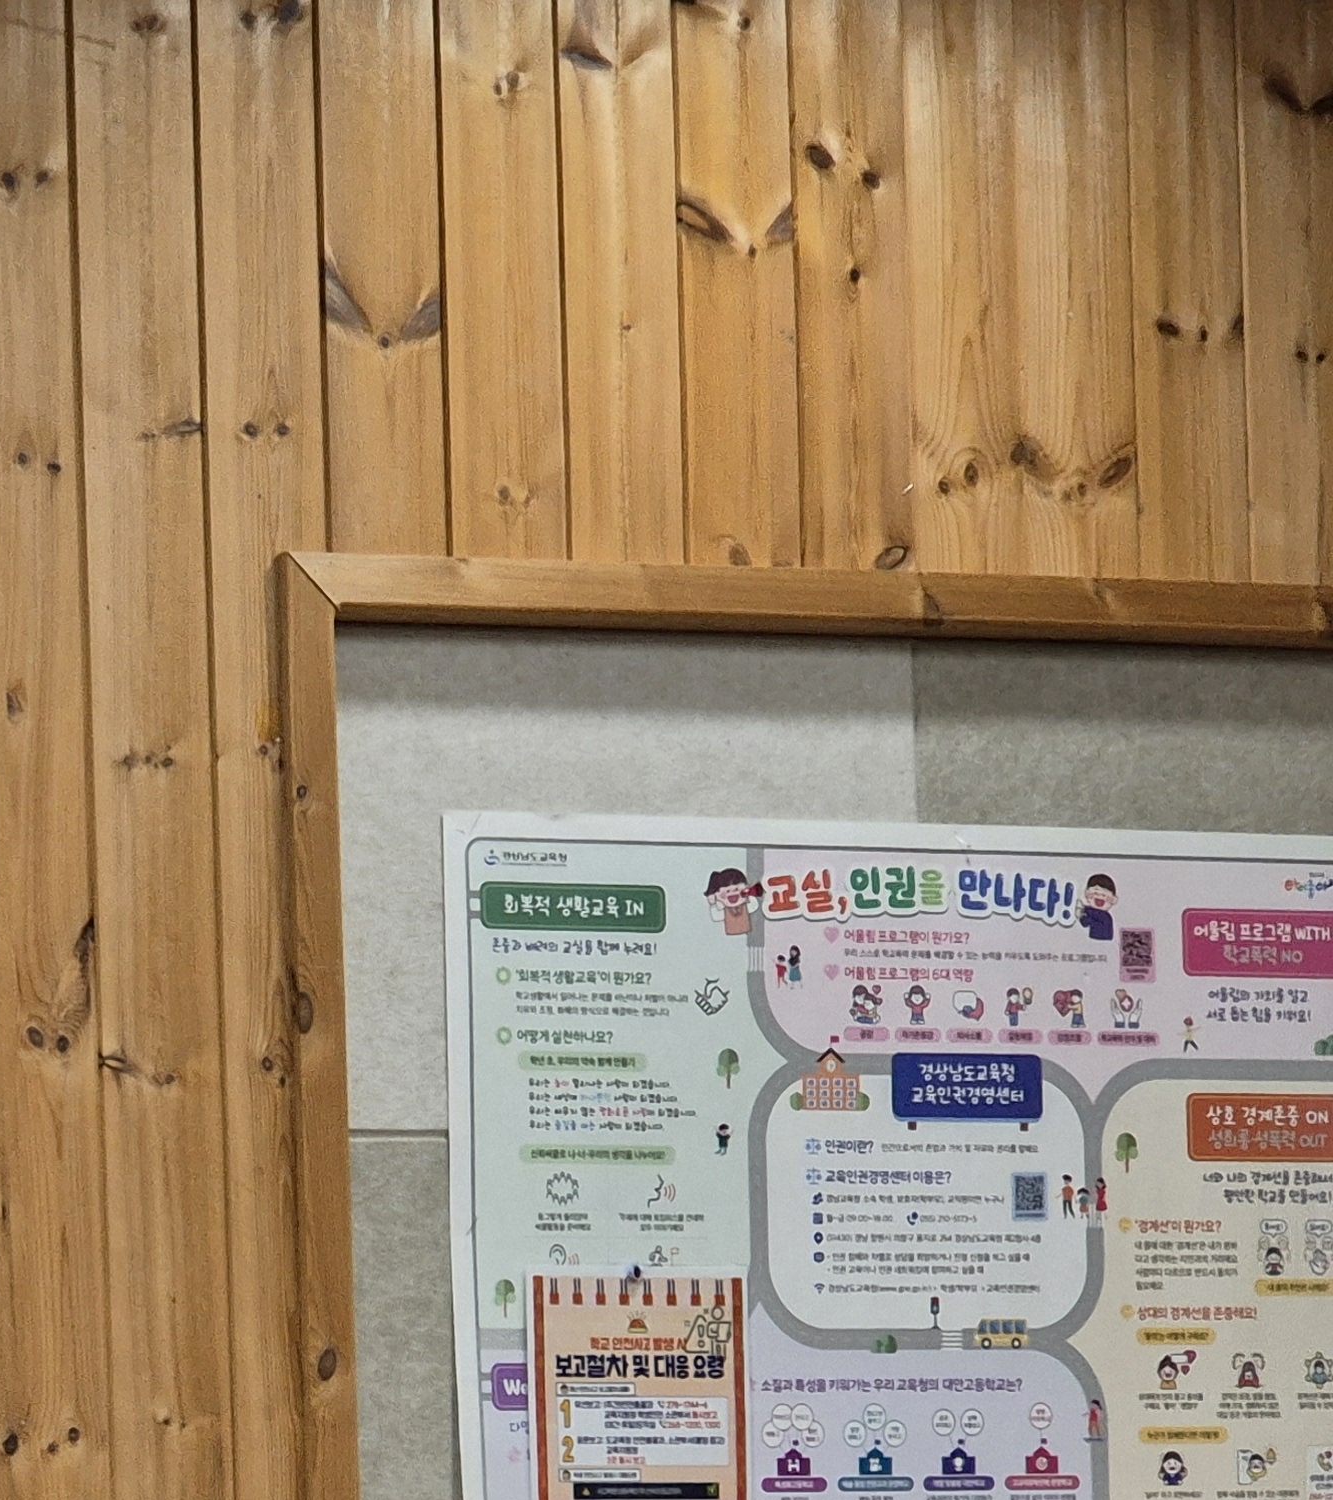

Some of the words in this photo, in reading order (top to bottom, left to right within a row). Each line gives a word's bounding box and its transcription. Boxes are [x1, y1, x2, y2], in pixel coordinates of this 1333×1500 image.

[766, 867, 848, 915] 교실,
[849, 865, 946, 910] 인권을
[957, 868, 1075, 921] 만나다!
[503, 893, 550, 918] 회복적
[556, 894, 620, 919] 생활교육
[625, 899, 645, 916] IN
[843, 928, 876, 944] 어울림
[877, 930, 930, 945] 프로그램이
[1193, 920, 1236, 942] 어울림
[1239, 921, 1292, 943] 프로그램
[1294, 925, 1332, 941] WITH
[1280, 949, 1304, 964] NO
[843, 966, 876, 981] 어울림
[877, 967, 930, 982] 프로그램의
[931, 967, 951, 982] 6대
[952, 967, 975, 983] 역량
[516, 1029, 550, 1045] 어떻게
[551, 1029, 614, 1045] 실천하나요?
[919, 1062, 1016, 1083] 경상남도교육청
[910, 1086, 1025, 1105] 교육인권경영센터
[1205, 1104, 1237, 1126] 상호
[1241, 1104, 1301, 1127] 경계존중
[1304, 1110, 1330, 1125] ON
[824, 1139, 874, 1154] 인권이란?
[1299, 1134, 1329, 1149] OUT
[554, 1353, 630, 1379] 보고절차
[632, 1355, 650, 1379] 및
[653, 1354, 690, 1379] 대응
[692, 1354, 725, 1379] 요령
[760, 1377, 794, 1392] 소질과
[828, 1377, 872, 1392] 키워가는
[873, 1377, 895, 1392] 우리
[559, 1399, 572, 1428] 1
[561, 1435, 575, 1463] 2
